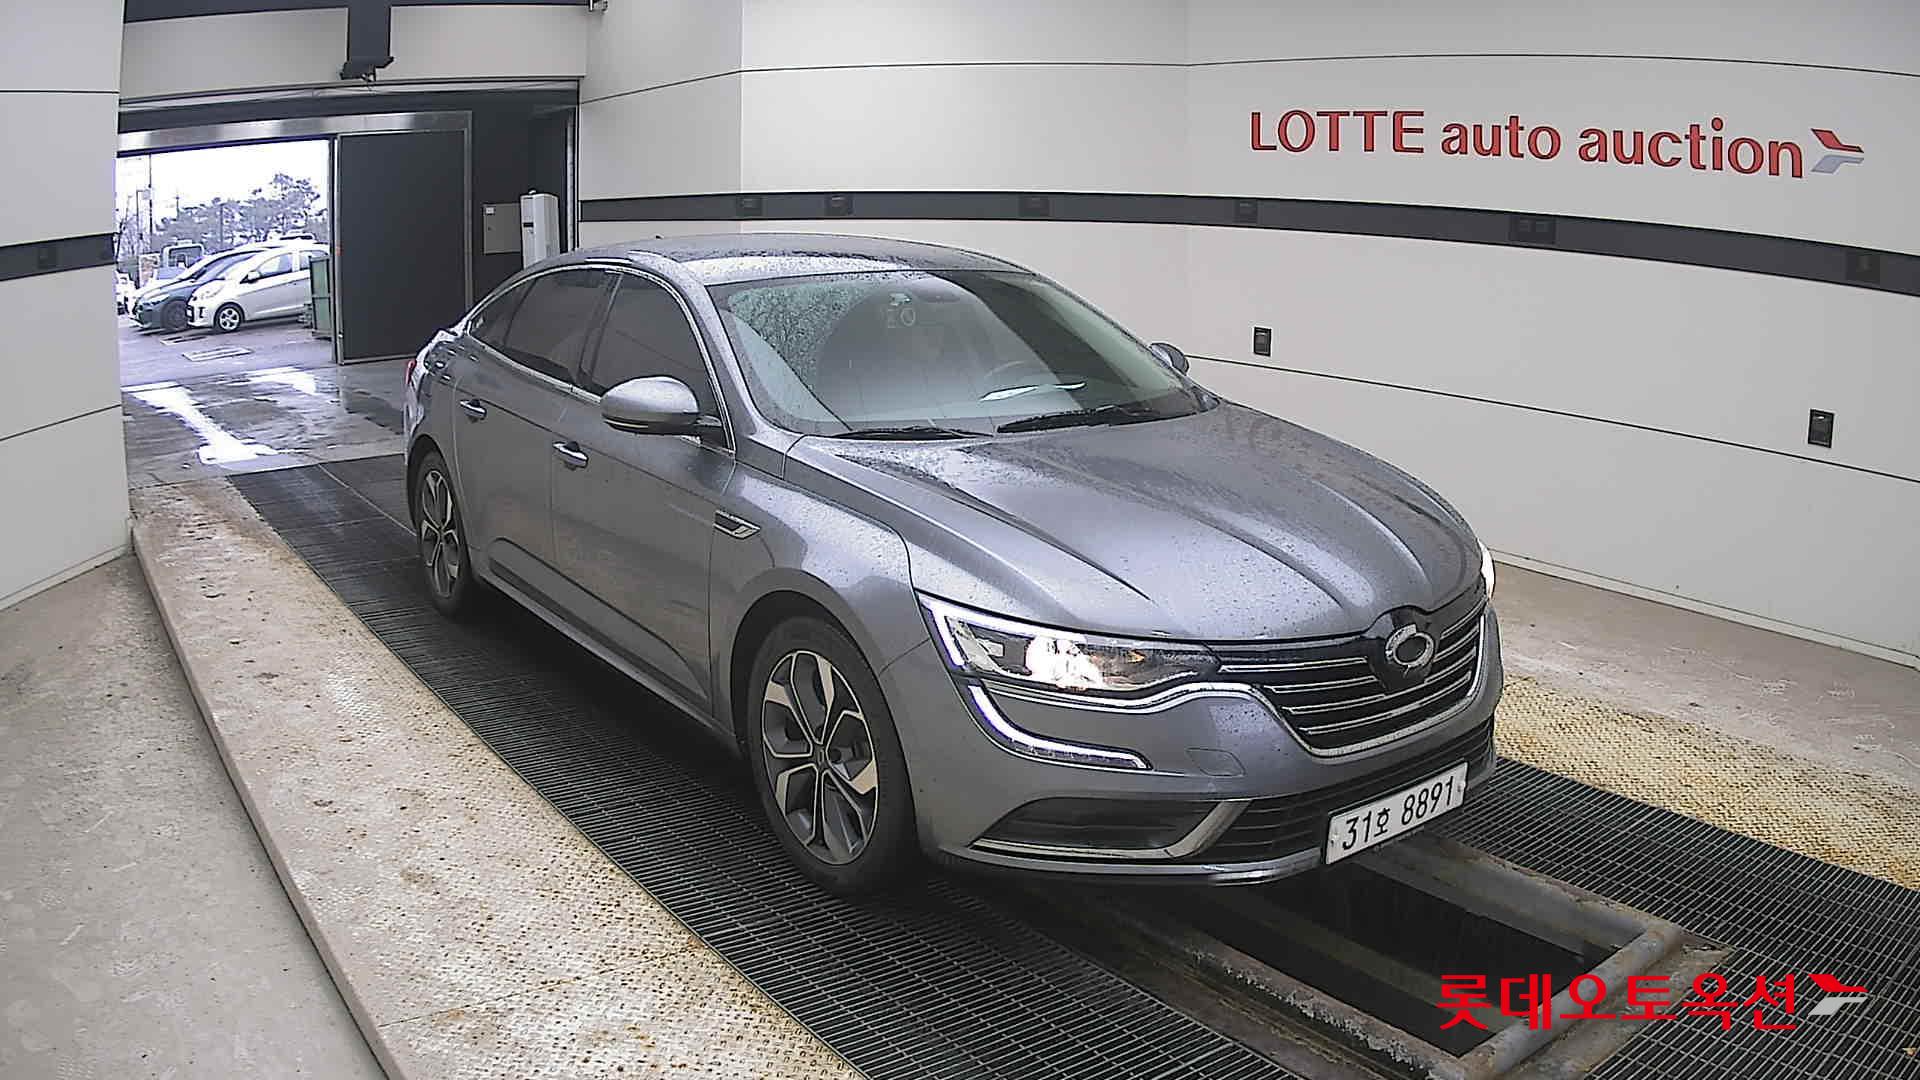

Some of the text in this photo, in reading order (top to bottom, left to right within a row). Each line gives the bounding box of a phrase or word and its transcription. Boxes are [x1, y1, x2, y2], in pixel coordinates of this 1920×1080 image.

[1250, 110, 1804, 178] LOTTE auto auction
[1342, 775, 1454, 850] 31호 8891
